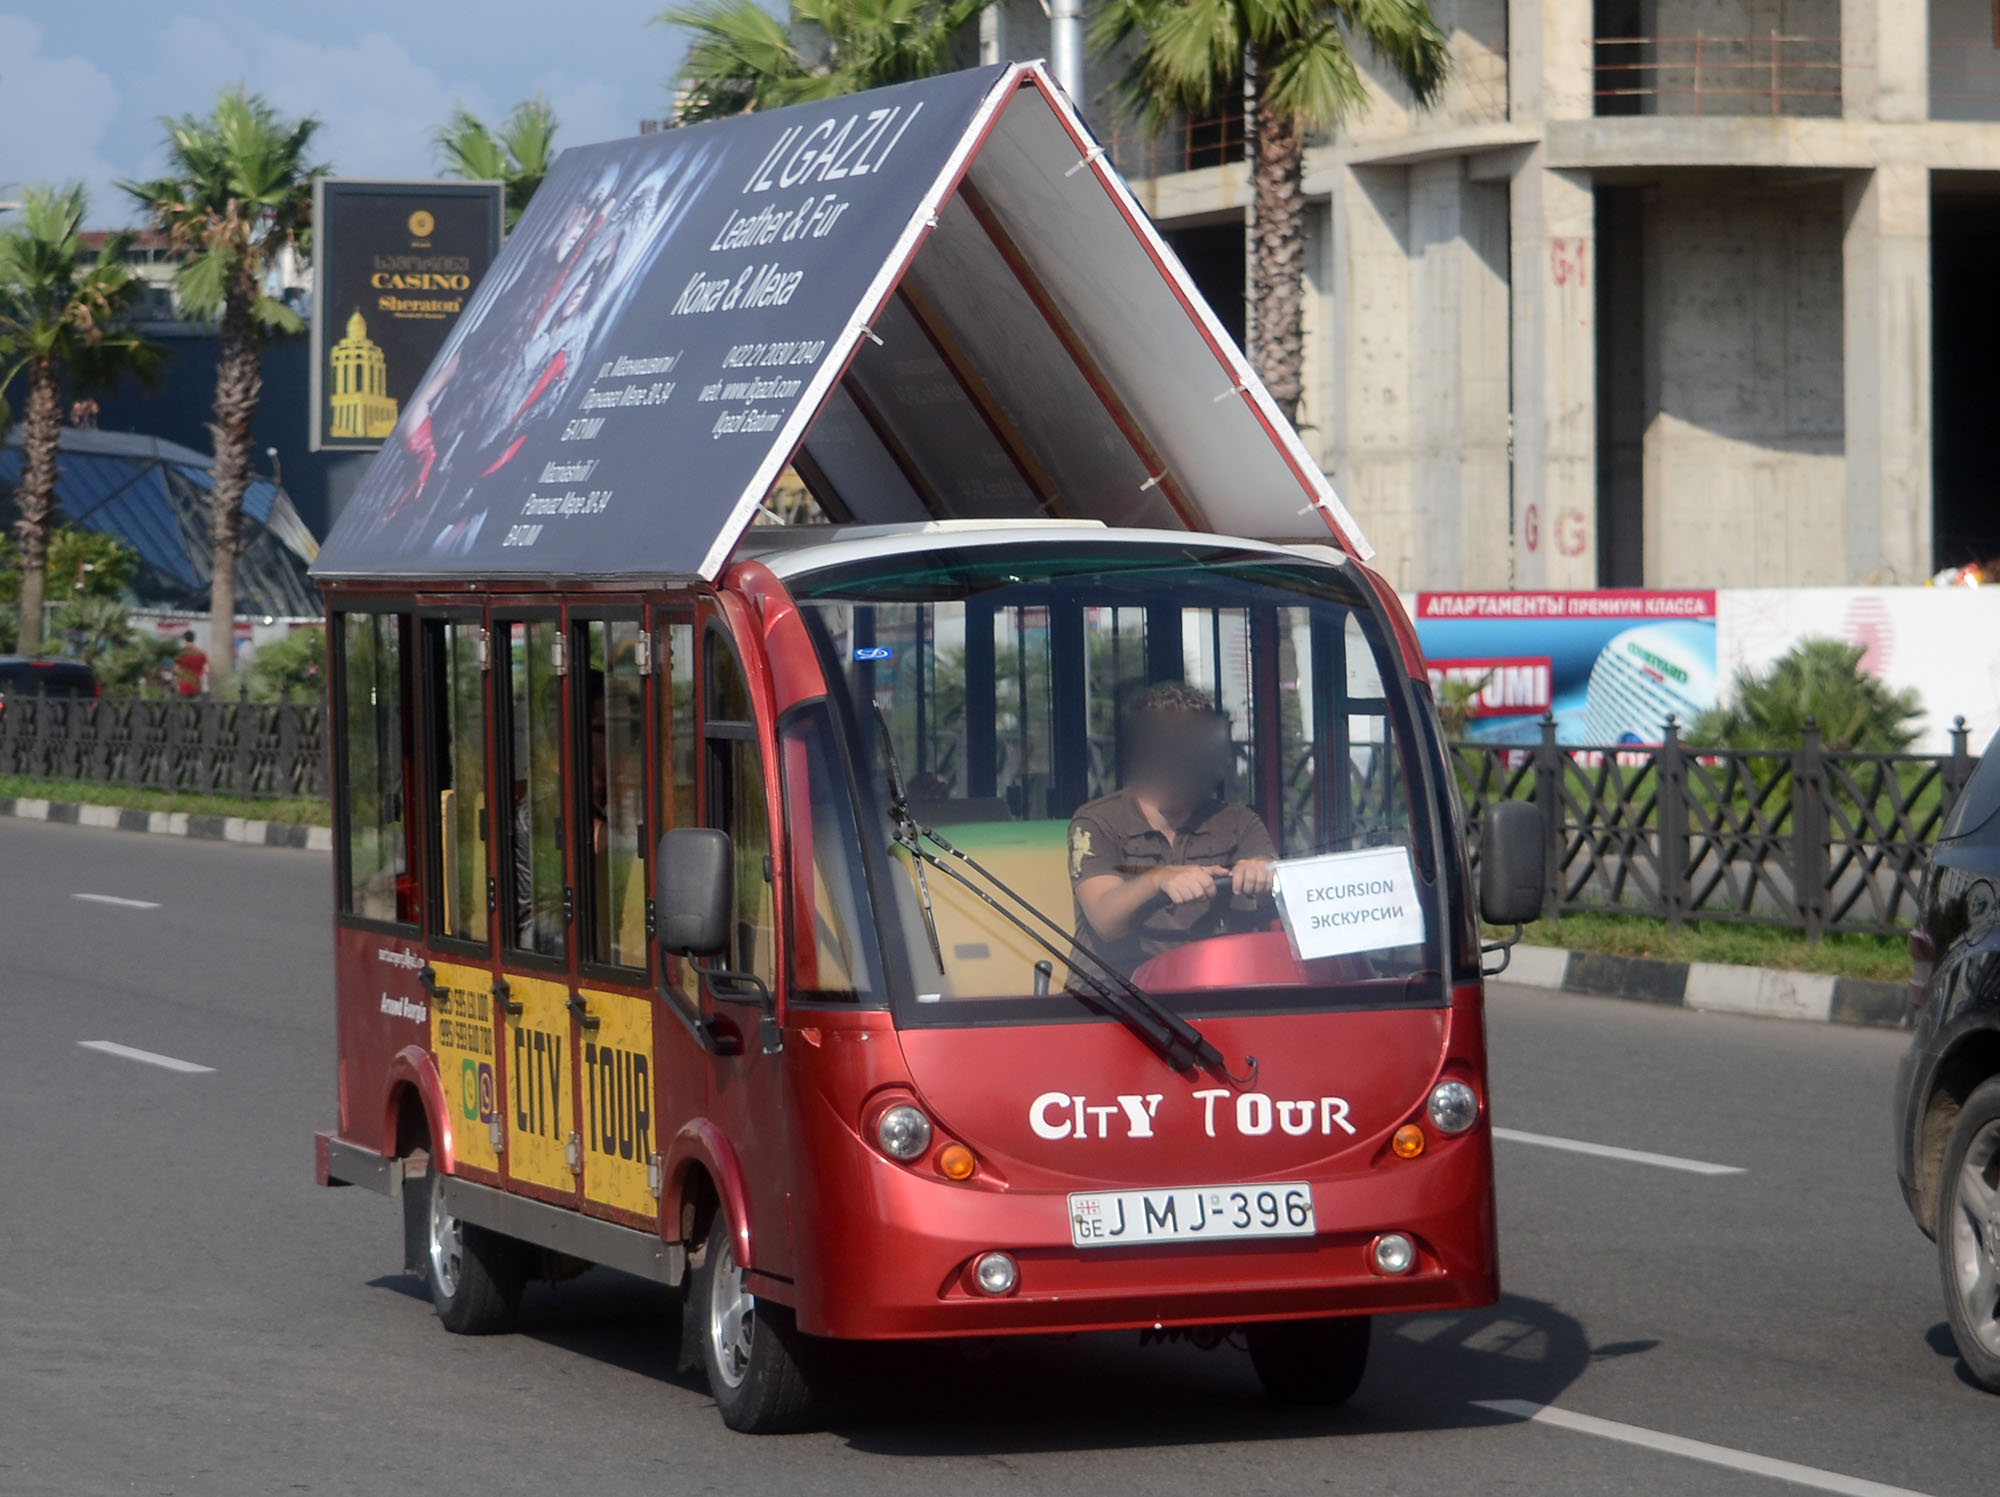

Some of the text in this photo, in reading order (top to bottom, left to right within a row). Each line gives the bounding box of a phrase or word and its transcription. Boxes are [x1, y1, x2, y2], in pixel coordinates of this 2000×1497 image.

[744, 103, 922, 192] ILGAZLI
[711, 194, 849, 250] Leather & Fur
[371, 272, 471, 291] CASINO
[671, 263, 802, 315] Кожа & Меха
[378, 296, 463, 313] Sheraton
[1427, 595, 1706, 616] АПАРТАМЕНТЫ ПРЕМИУМ КЛАССА
[1306, 880, 1394, 902] EXCURSION
[1311, 906, 1404, 929] ЭКСКУРСИИ
[515, 1027, 651, 1165] CITY TOUR
[1078, 1219, 1104, 1239] GE
